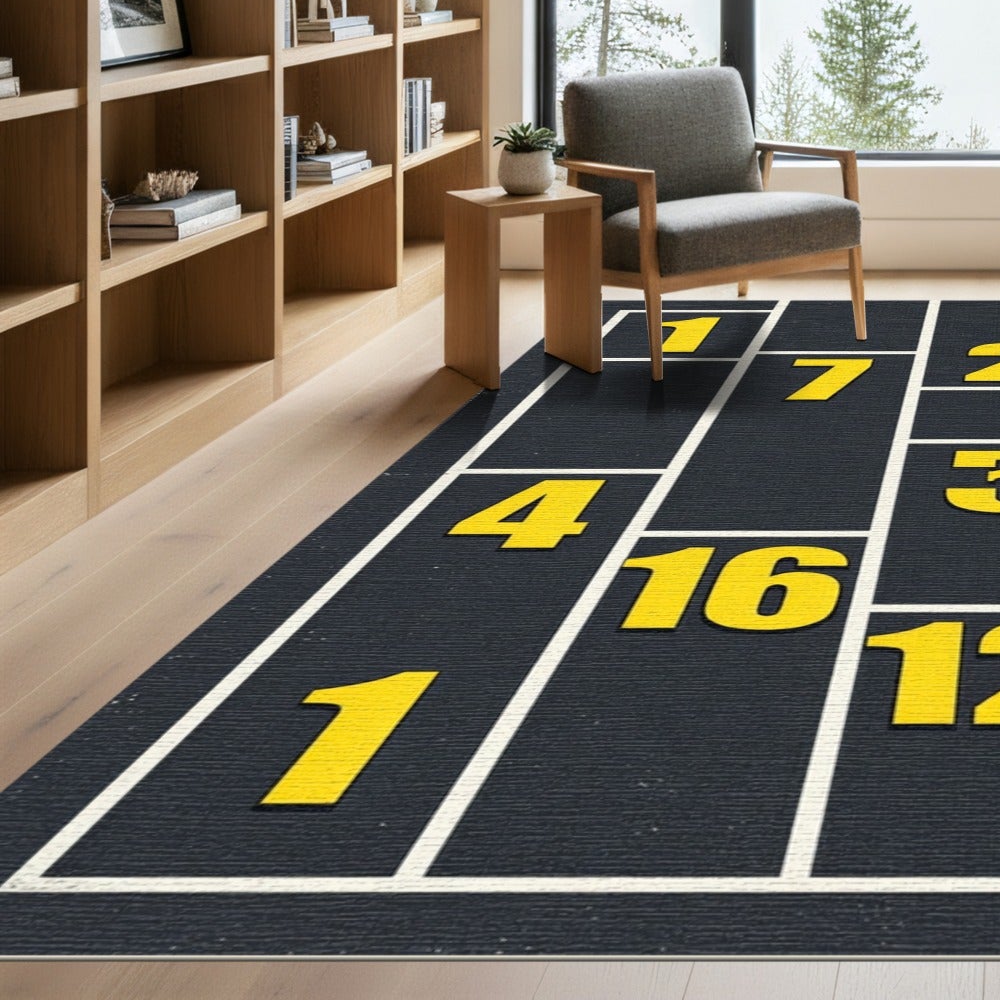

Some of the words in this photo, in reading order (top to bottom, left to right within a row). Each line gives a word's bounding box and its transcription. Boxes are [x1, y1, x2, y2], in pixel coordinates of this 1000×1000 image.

[661, 316, 721, 353] 1
[785, 358, 874, 401] 7
[448, 479, 605, 550] 4
[622, 545, 850, 632] 16
[261, 670, 439, 806] 1
